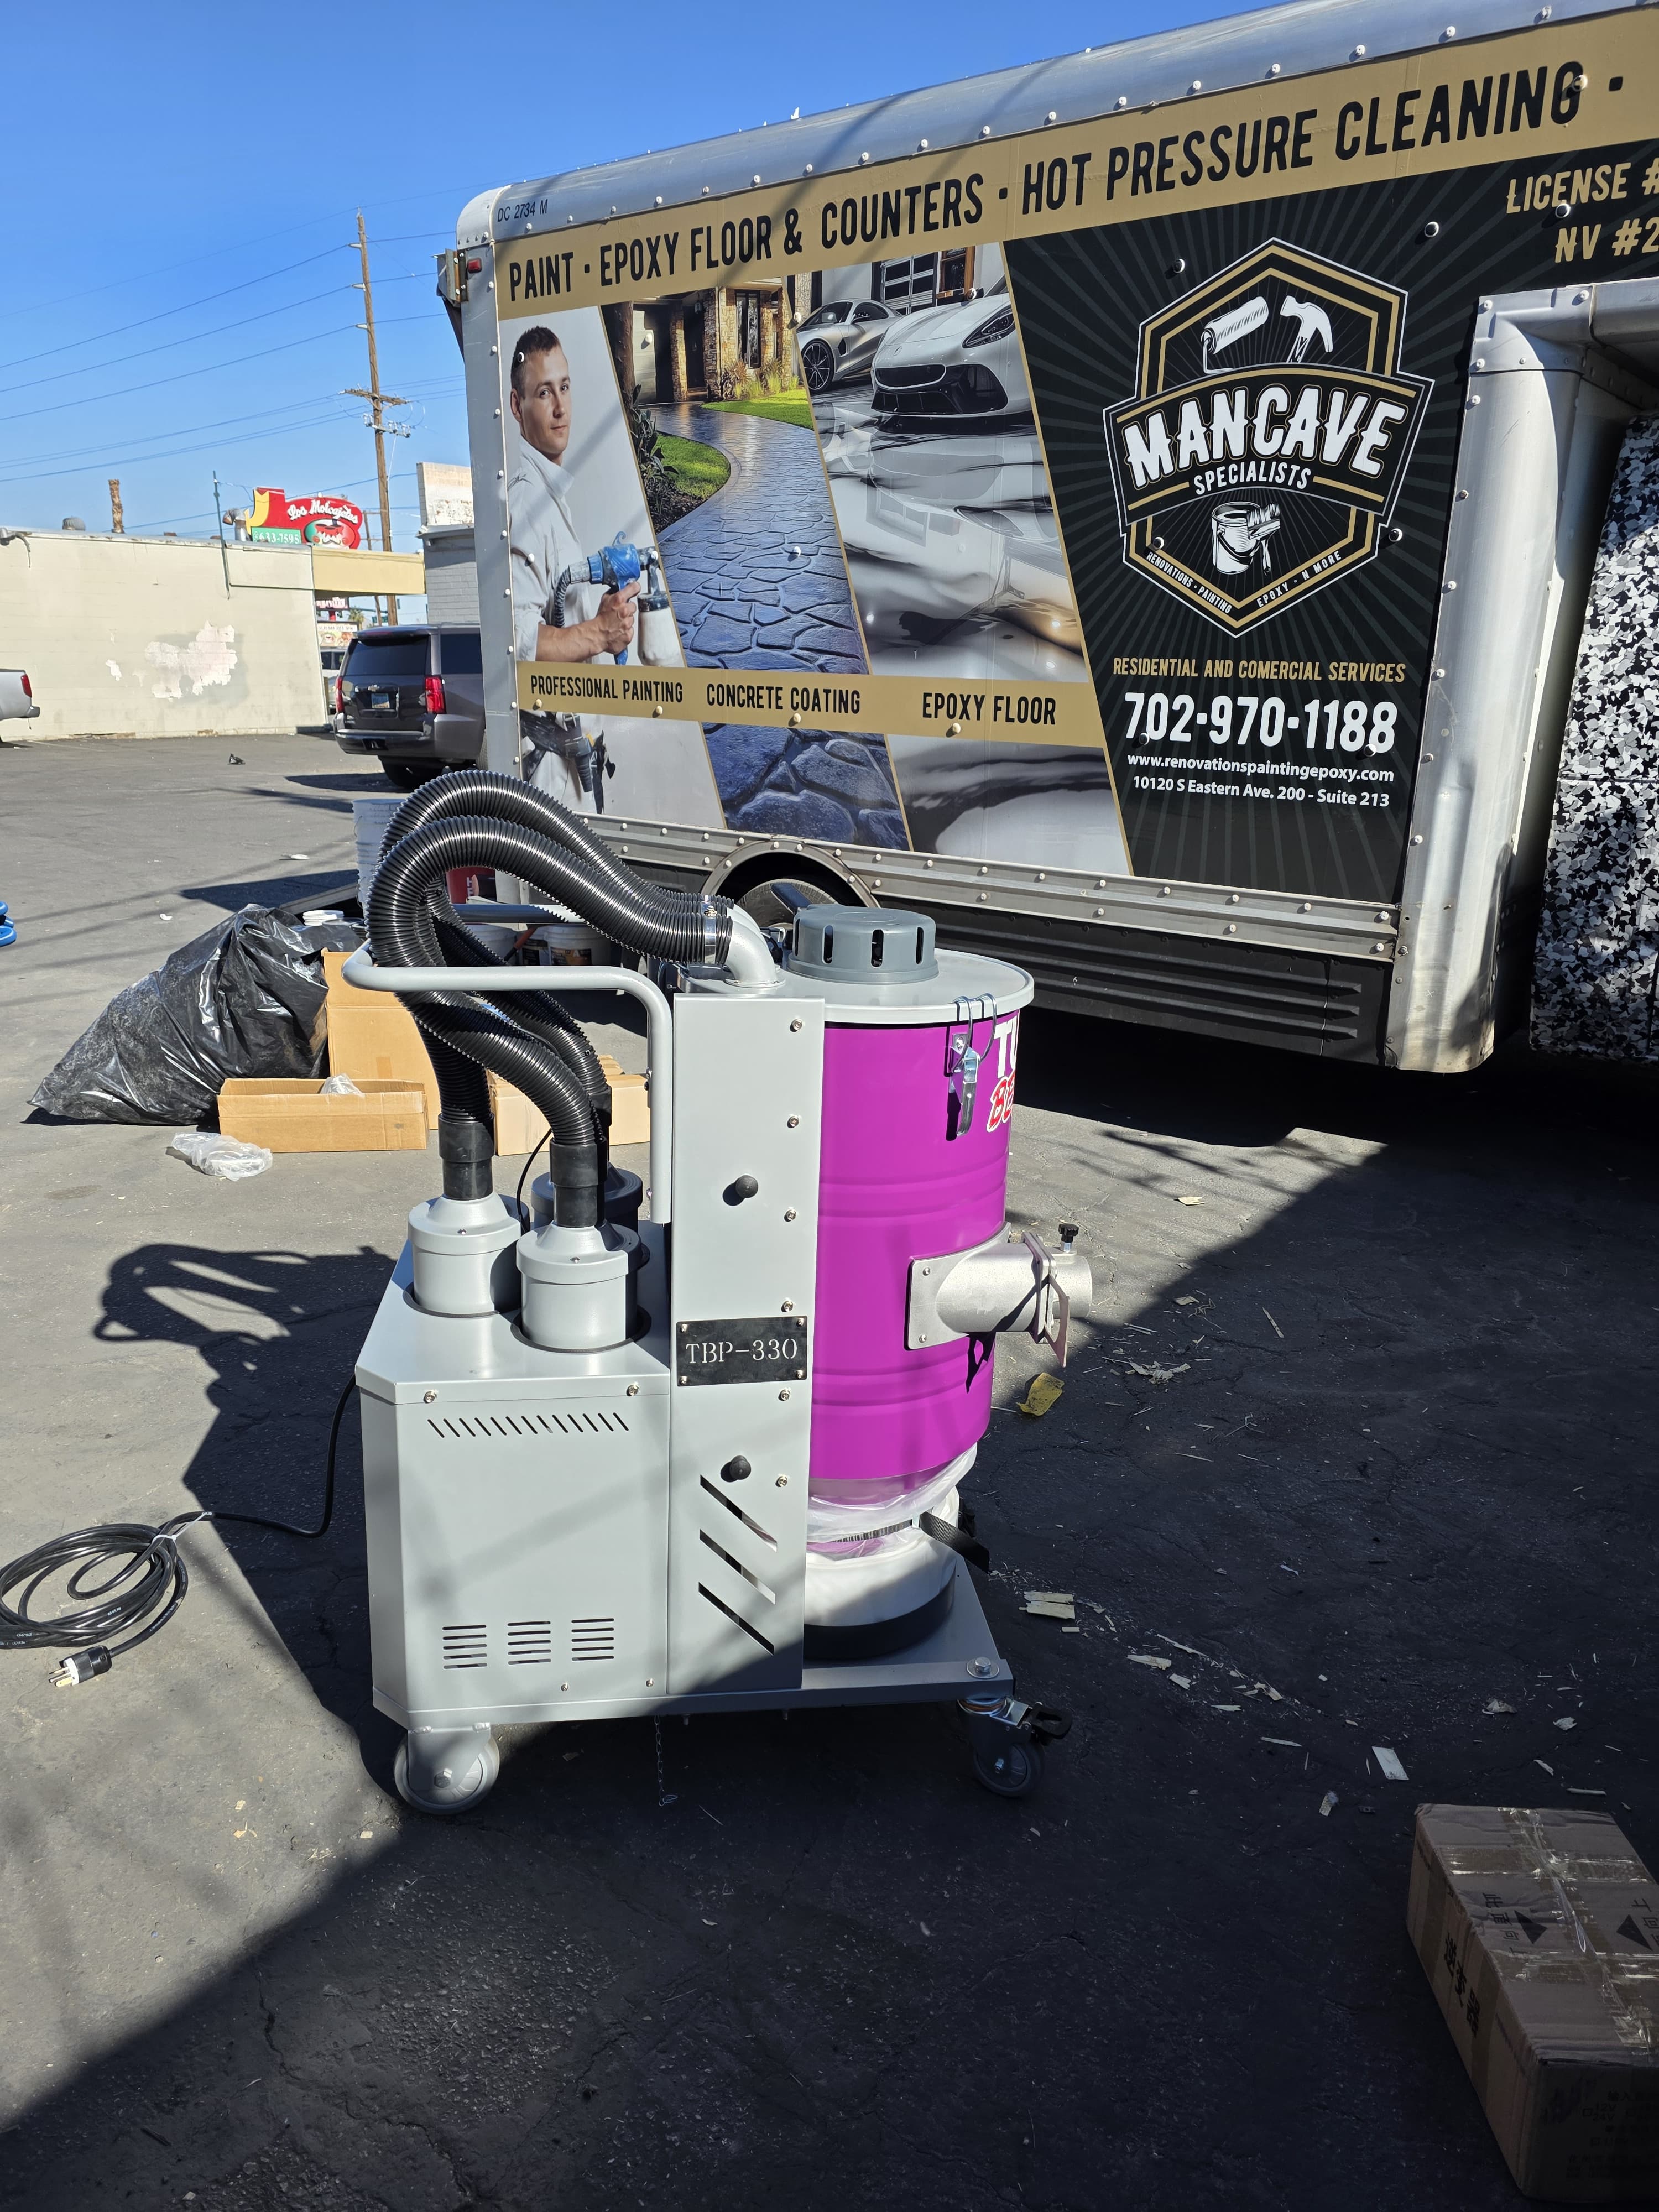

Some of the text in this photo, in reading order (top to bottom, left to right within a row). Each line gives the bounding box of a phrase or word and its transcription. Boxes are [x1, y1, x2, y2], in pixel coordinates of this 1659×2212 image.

[510, 61, 1584, 301] PAINT EPOXY FLOOR & COUNTERS HOT PRESSURE CLEANING
[1506, 162, 1631, 213] LICENSE
[498, 199, 548, 222] DC 2734 M
[1555, 223, 1602, 263] NV
[1124, 387, 1405, 487] MANCAVE
[1193, 461, 1311, 495] SPECIALISTS
[287, 504, 307, 520] Los
[1146, 551, 1232, 614] RENOVATIONS PAINTING
[1256, 550, 1342, 607] EPOXY N MORE
[1113, 658, 1406, 683] RESIDENTIAL AND COMERCIAL SERVICES
[530, 675, 682, 703] PROFESSIONAL PAINTING
[707, 683, 860, 714] CONCRETE COATING
[922, 692, 1056, 725] EPOXY FLOOR
[1127, 753, 1394, 782] www.renovationspaintingepoxy.com
[1133, 776, 1173, 791] 10120
[1176, 779, 1185, 792] S
[1188, 779, 1239, 796] Eastern
[1243, 783, 1274, 799] Ave.
[1277, 786, 1305, 801] 200
[1317, 789, 1357, 805] Suite
[1359, 792, 1390, 807] 213
[685, 1338, 797, 1364] TBP-330
